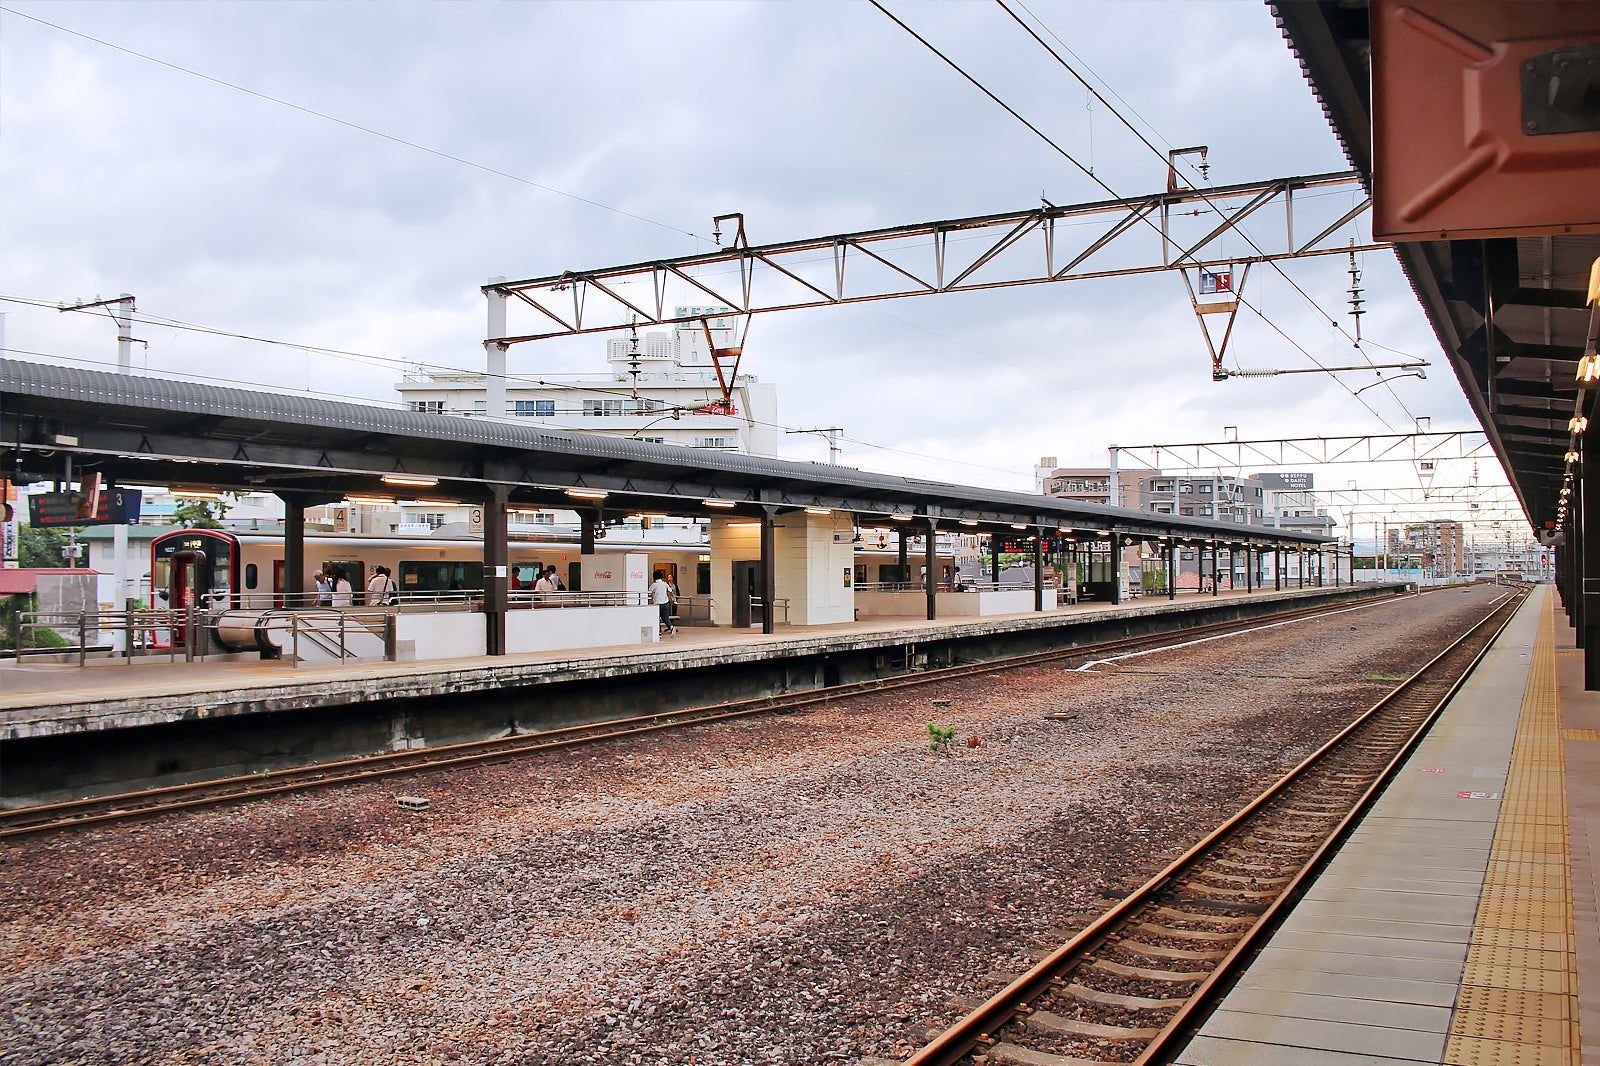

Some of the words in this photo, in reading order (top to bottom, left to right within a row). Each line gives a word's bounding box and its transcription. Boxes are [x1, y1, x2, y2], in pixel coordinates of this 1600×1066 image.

[116, 493, 123, 506] 3
[336, 509, 344, 523] 4
[472, 509, 481, 524] 3
